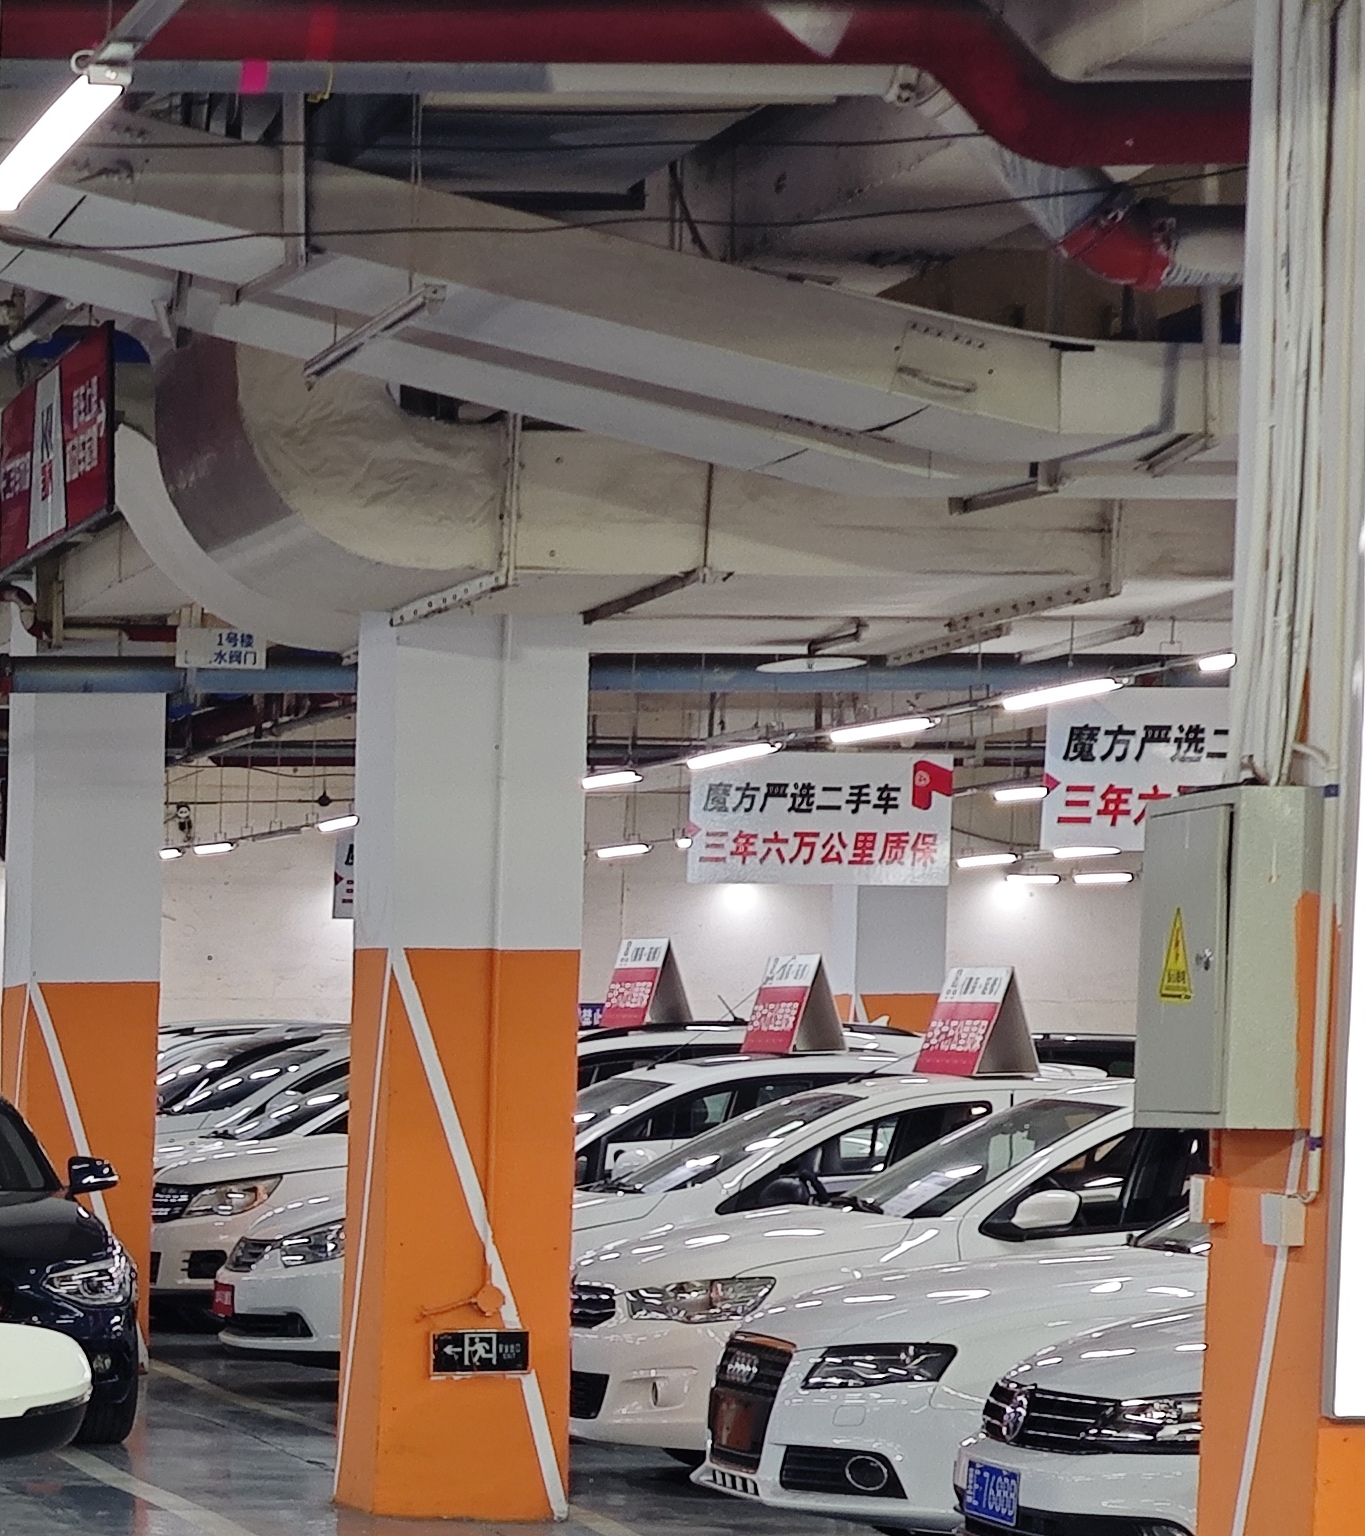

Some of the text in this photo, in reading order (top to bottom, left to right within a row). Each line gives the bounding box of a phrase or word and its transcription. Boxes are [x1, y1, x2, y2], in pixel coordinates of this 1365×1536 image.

[703, 782, 901, 814] 魔方严选二手车
[1057, 784, 1195, 826] 三年六
[699, 830, 938, 866] 三年六万公里质保
